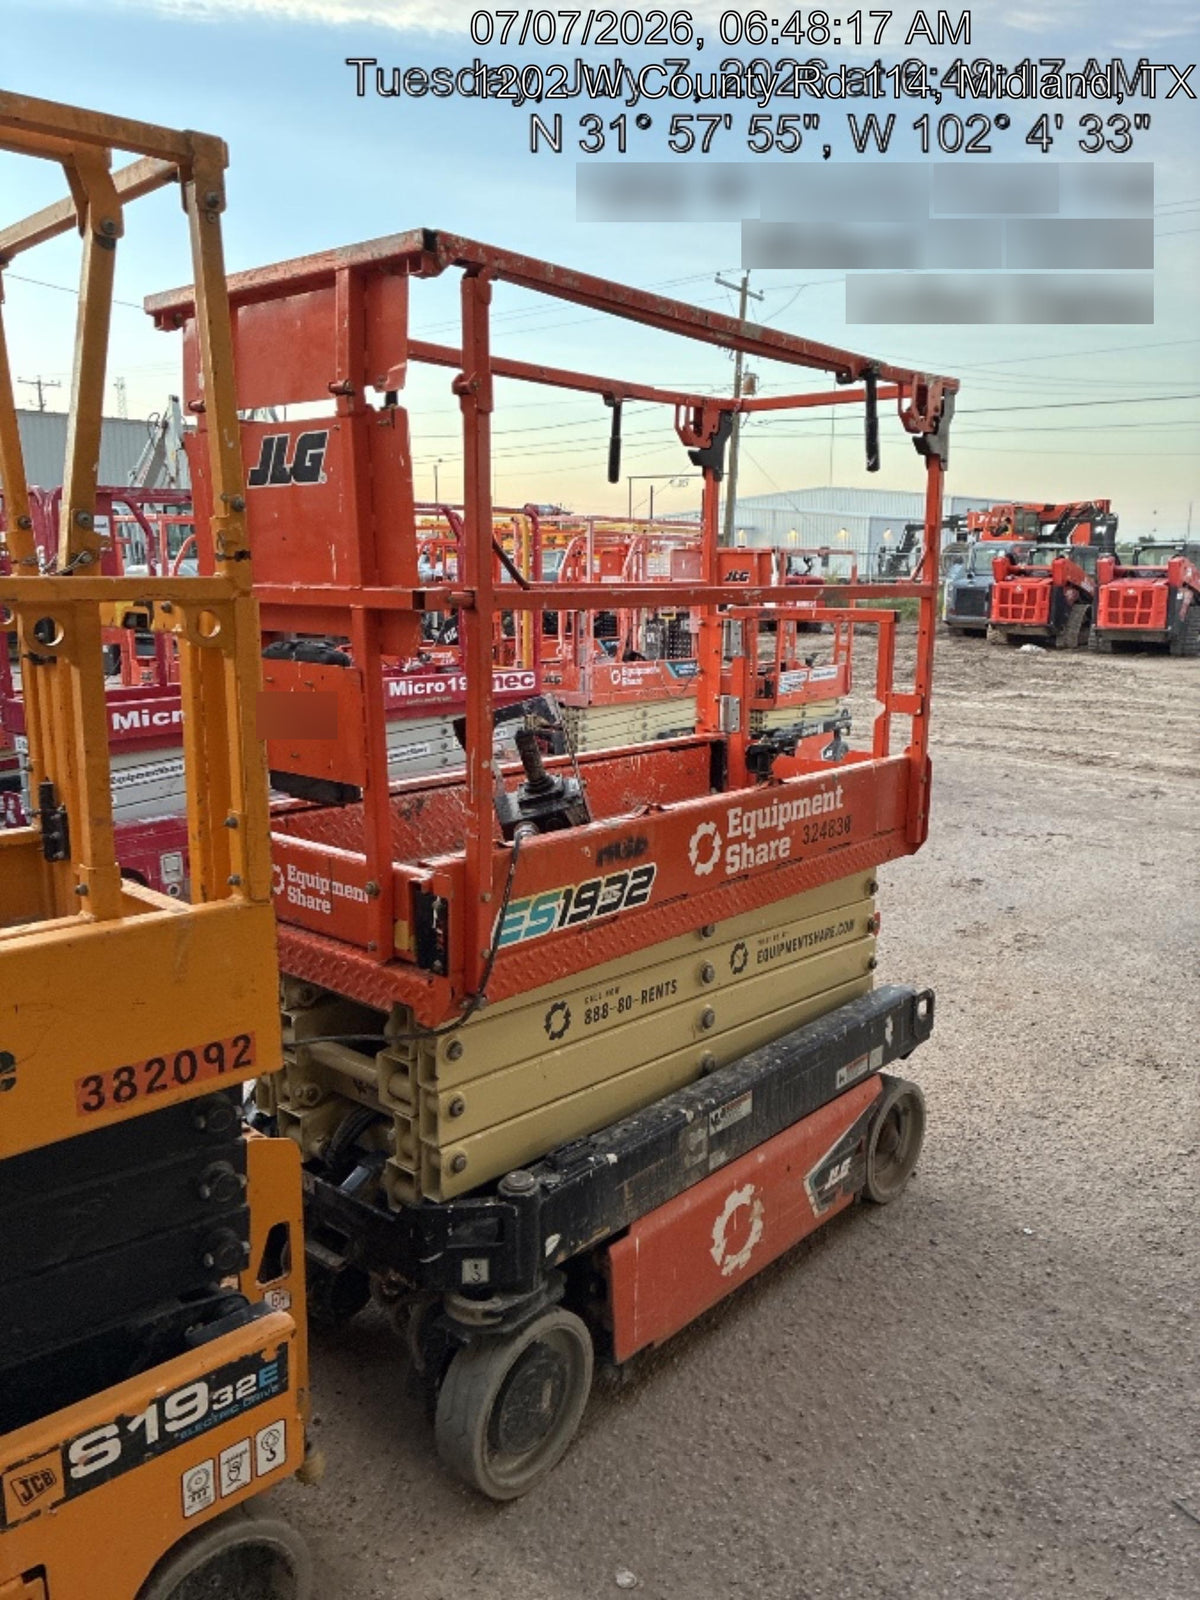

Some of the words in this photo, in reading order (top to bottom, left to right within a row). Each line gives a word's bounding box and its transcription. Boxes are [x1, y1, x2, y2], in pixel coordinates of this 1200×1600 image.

[247, 430, 329, 488] JLG
[726, 784, 844, 839] Equipment
[726, 836, 791, 875] Share
[287, 885, 331, 914] Share
[490, 863, 656, 949] ES1932
[584, 979, 678, 1025] 888-80-RENTS
[81, 1034, 252, 1112] 382092
[20, 1468, 55, 1504] JCB
